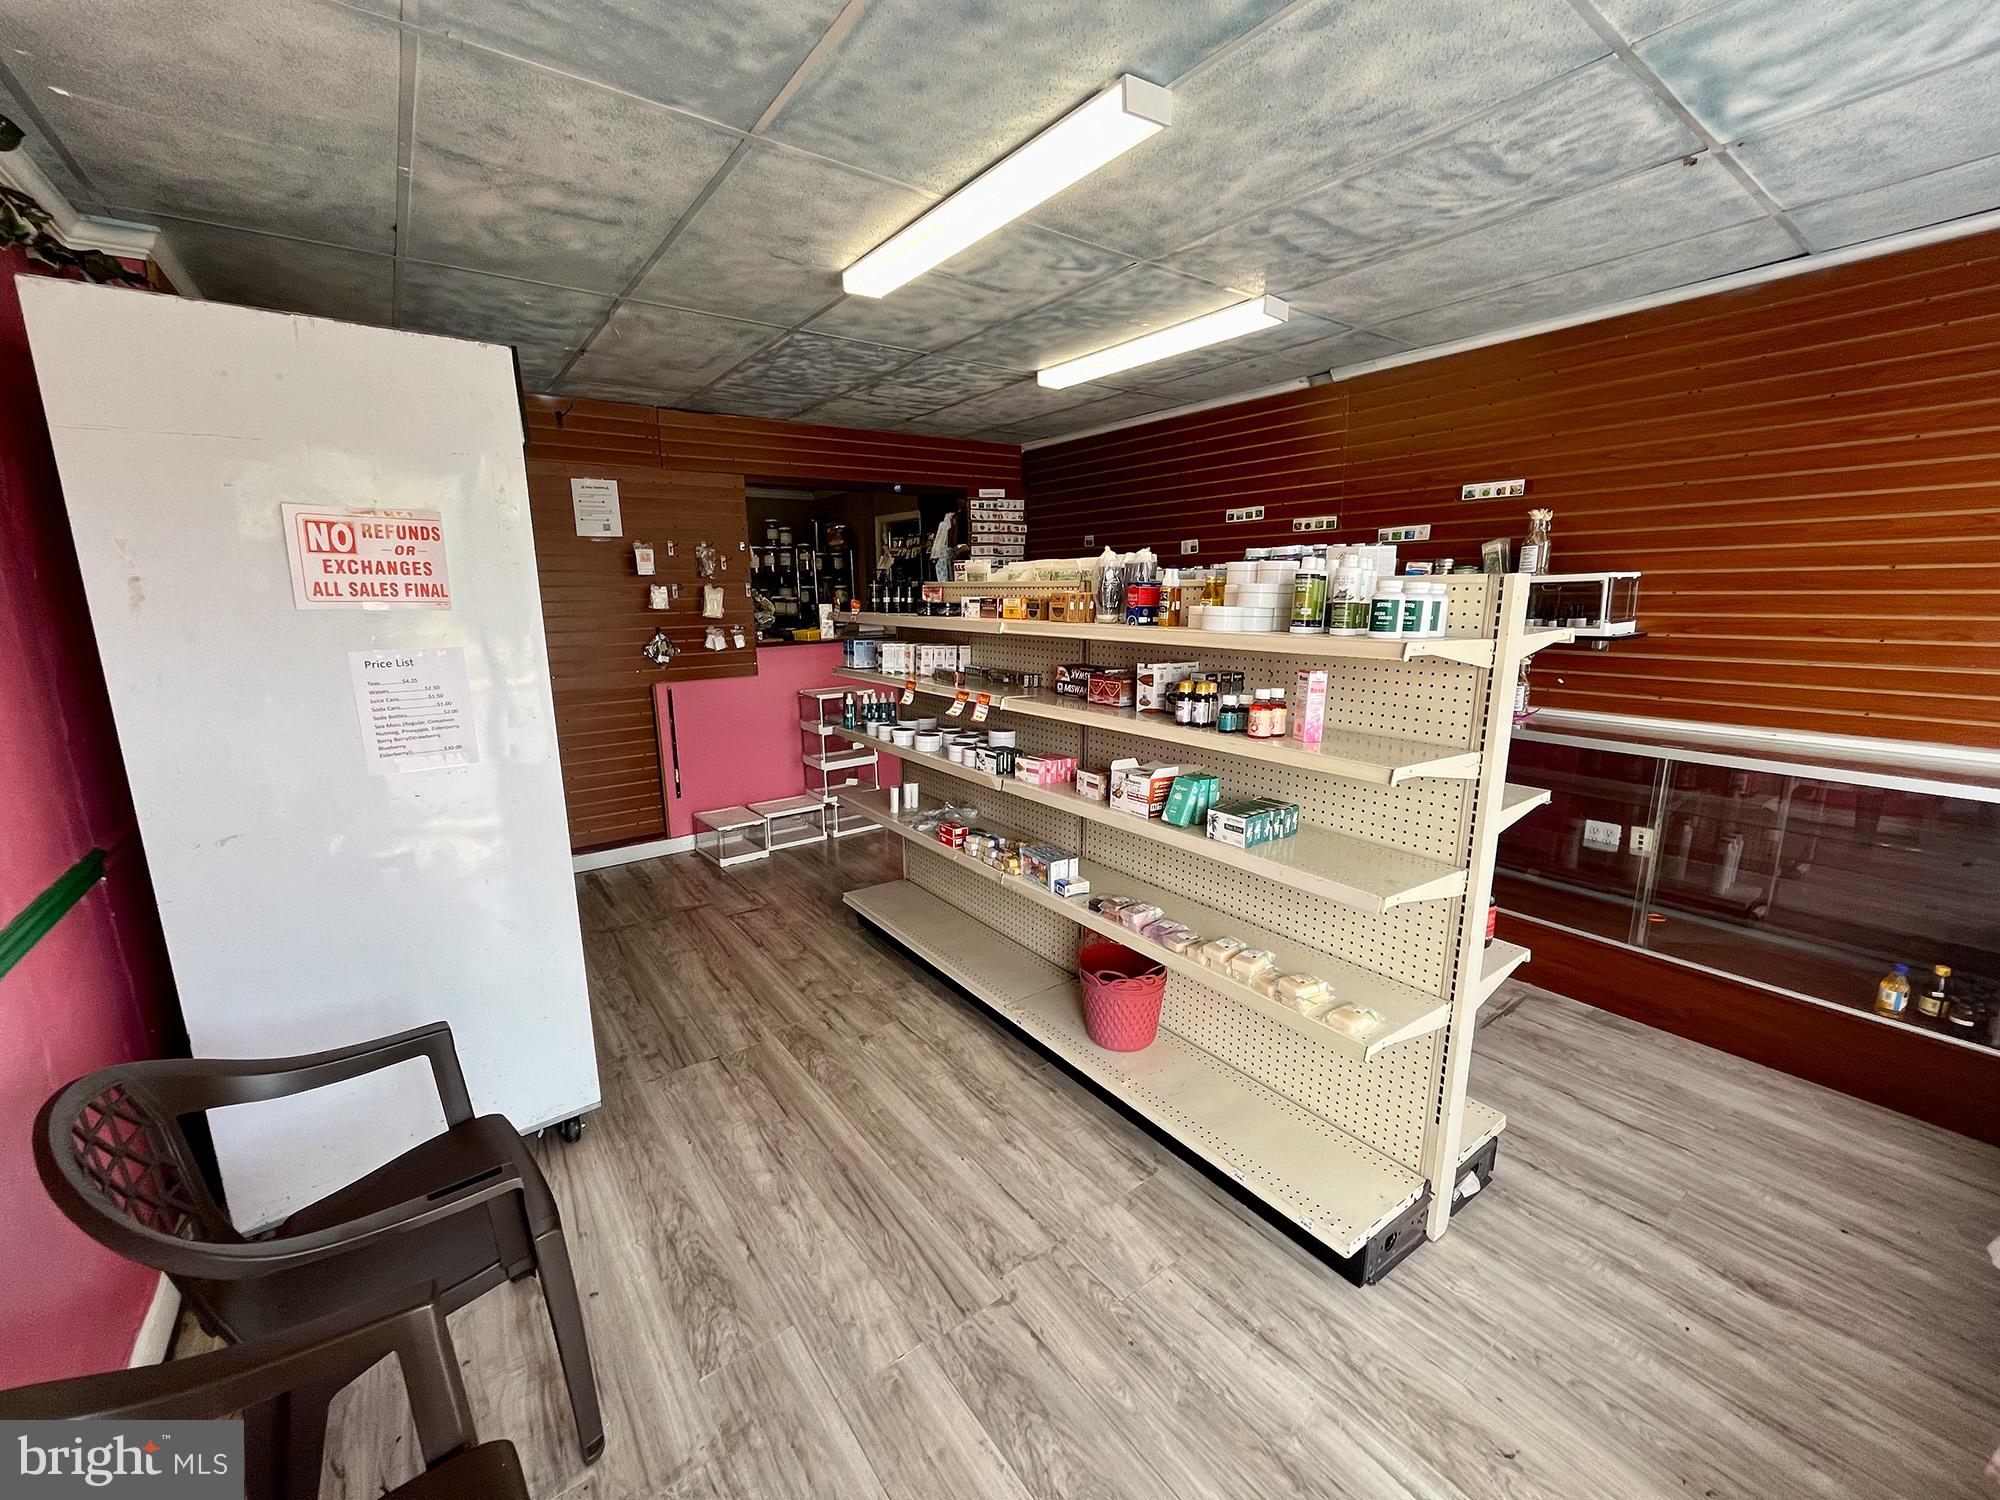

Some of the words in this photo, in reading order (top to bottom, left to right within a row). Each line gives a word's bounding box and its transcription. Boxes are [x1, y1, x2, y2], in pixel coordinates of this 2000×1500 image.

[306, 521, 355, 552] NO
[360, 523, 440, 541] REFUNDS
[394, 545, 416, 555] OR
[322, 559, 433, 576] EXCHANGES
[313, 581, 344, 597] ALL
[348, 581, 399, 597] SALES
[404, 582, 449, 598] FINAL
[364, 660, 392, 669] Price
[396, 659, 415, 668] List
